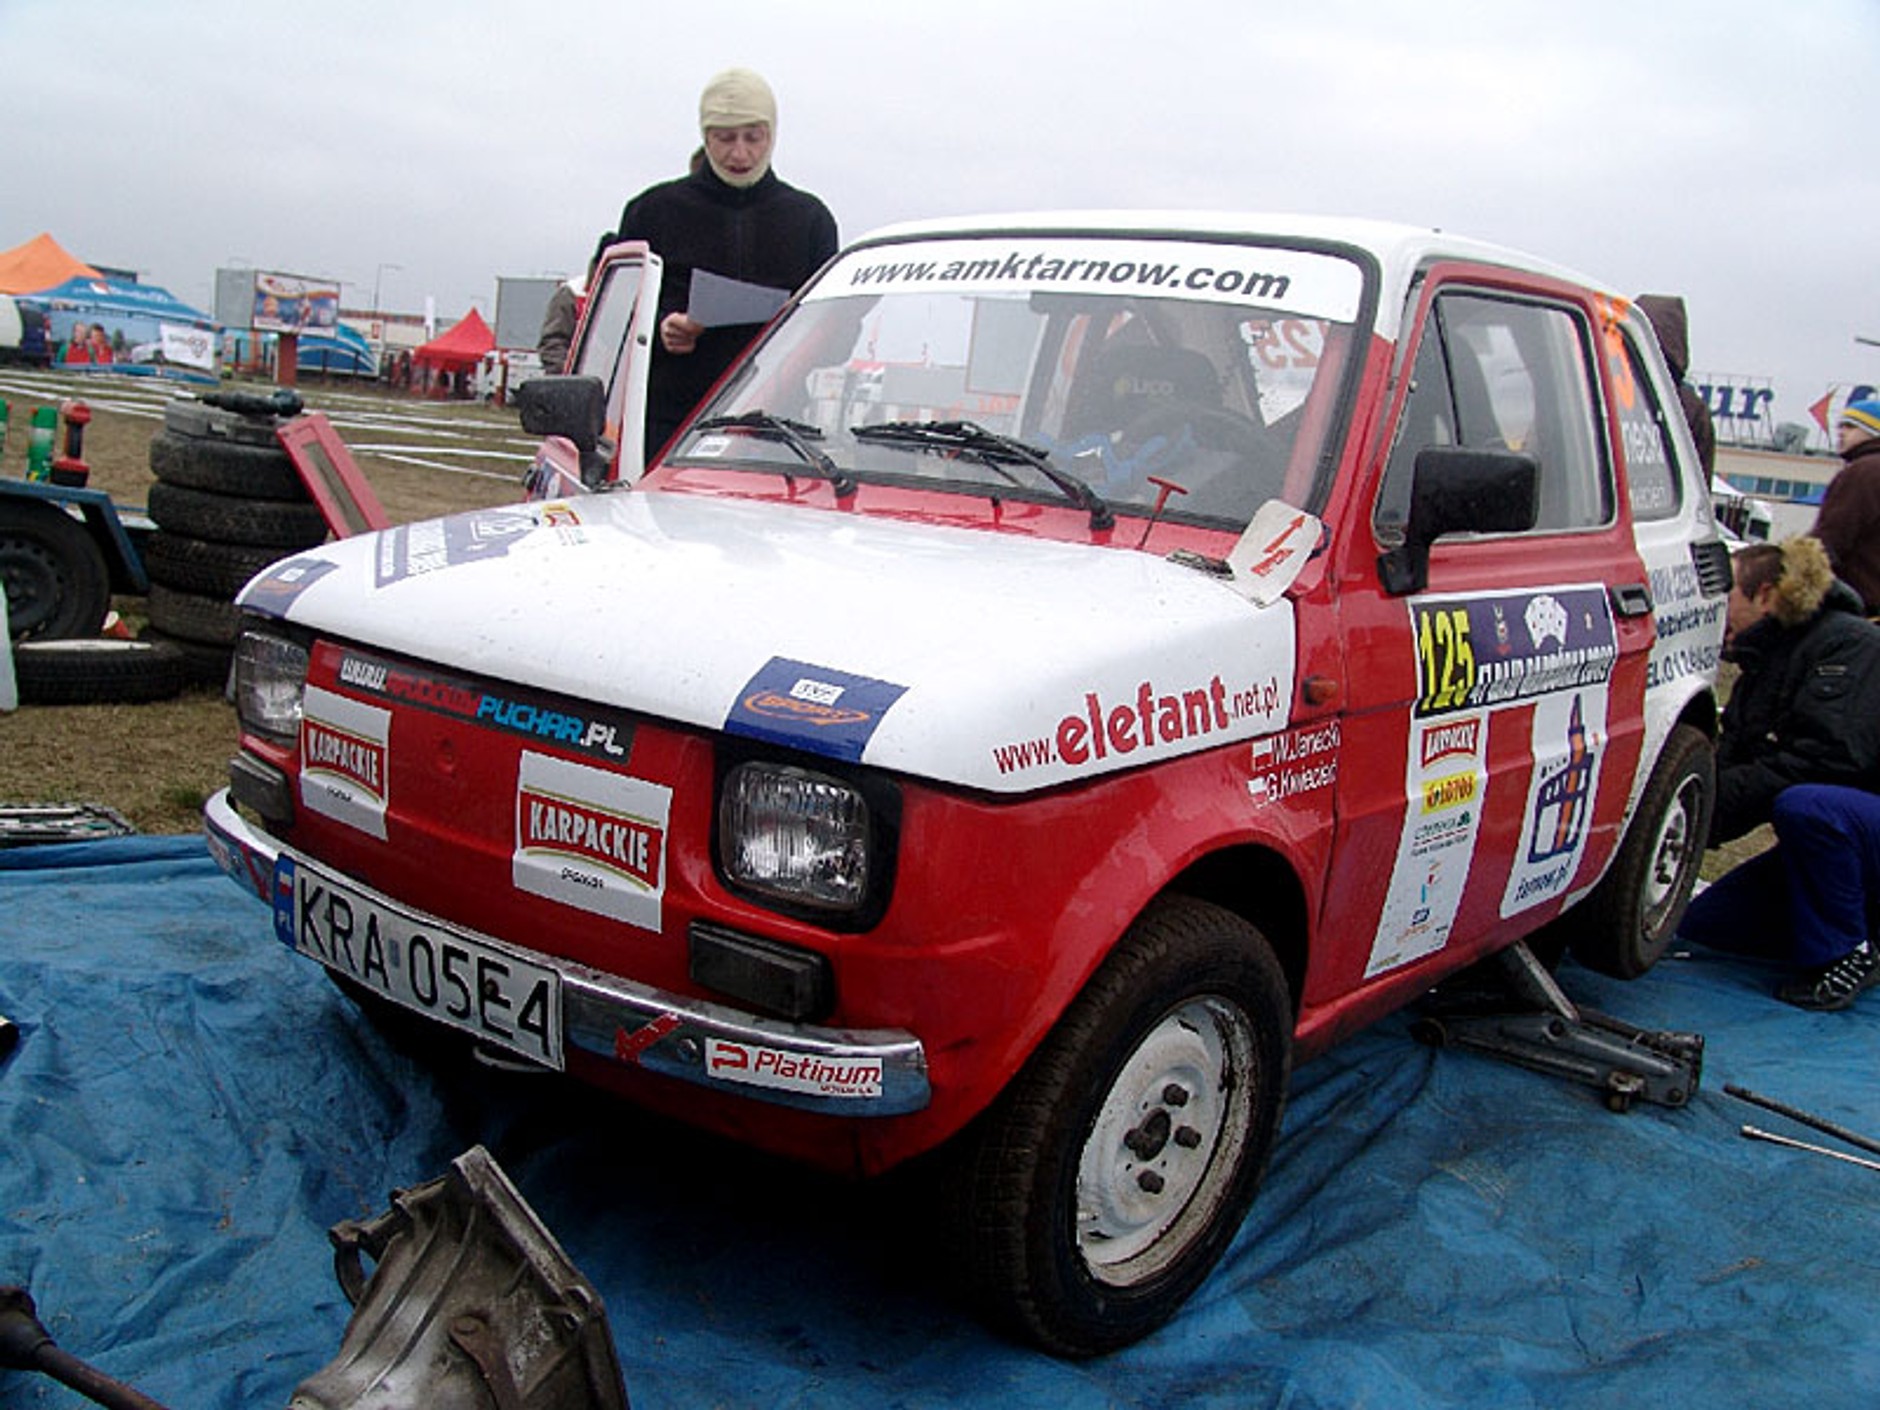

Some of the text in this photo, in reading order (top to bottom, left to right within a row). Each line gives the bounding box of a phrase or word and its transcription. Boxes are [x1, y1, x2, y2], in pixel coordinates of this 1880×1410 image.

[852, 252, 1291, 299] www.amktarnow.com
[1420, 610, 1474, 711] 125
[307, 728, 378, 787] KARPACKIE
[993, 674, 1280, 774] www.elefant.net.pl
[530, 801, 649, 874] KARPACKIE
[299, 877, 552, 1057] KRA 05E4
[754, 1050, 880, 1085] Platinum
